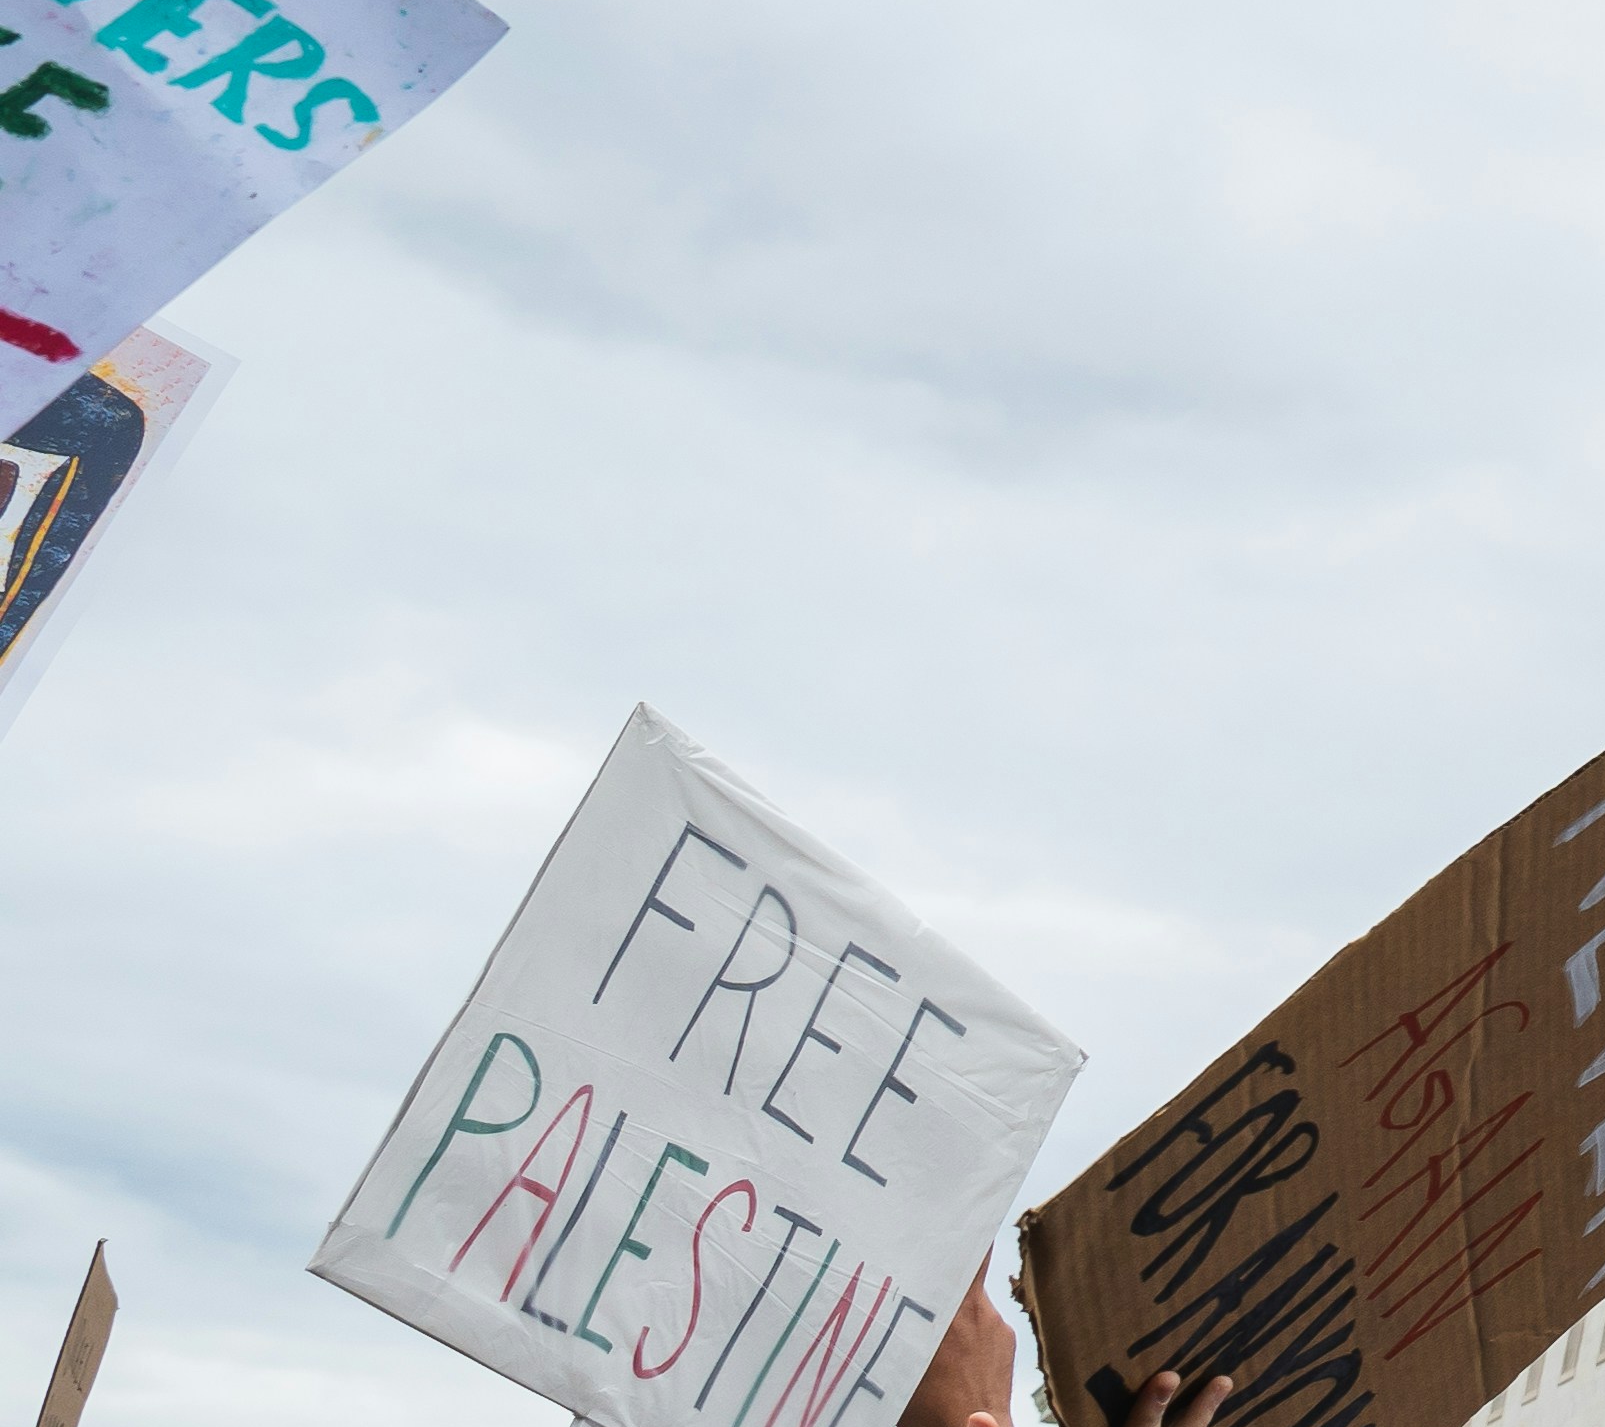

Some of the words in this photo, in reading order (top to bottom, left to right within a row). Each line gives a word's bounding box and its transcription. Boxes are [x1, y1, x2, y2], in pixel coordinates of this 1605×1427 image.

[592, 820, 968, 1187] FREE
[1105, 1040, 1320, 1305] FOR
[1338, 940, 1546, 1361] AGAIN
